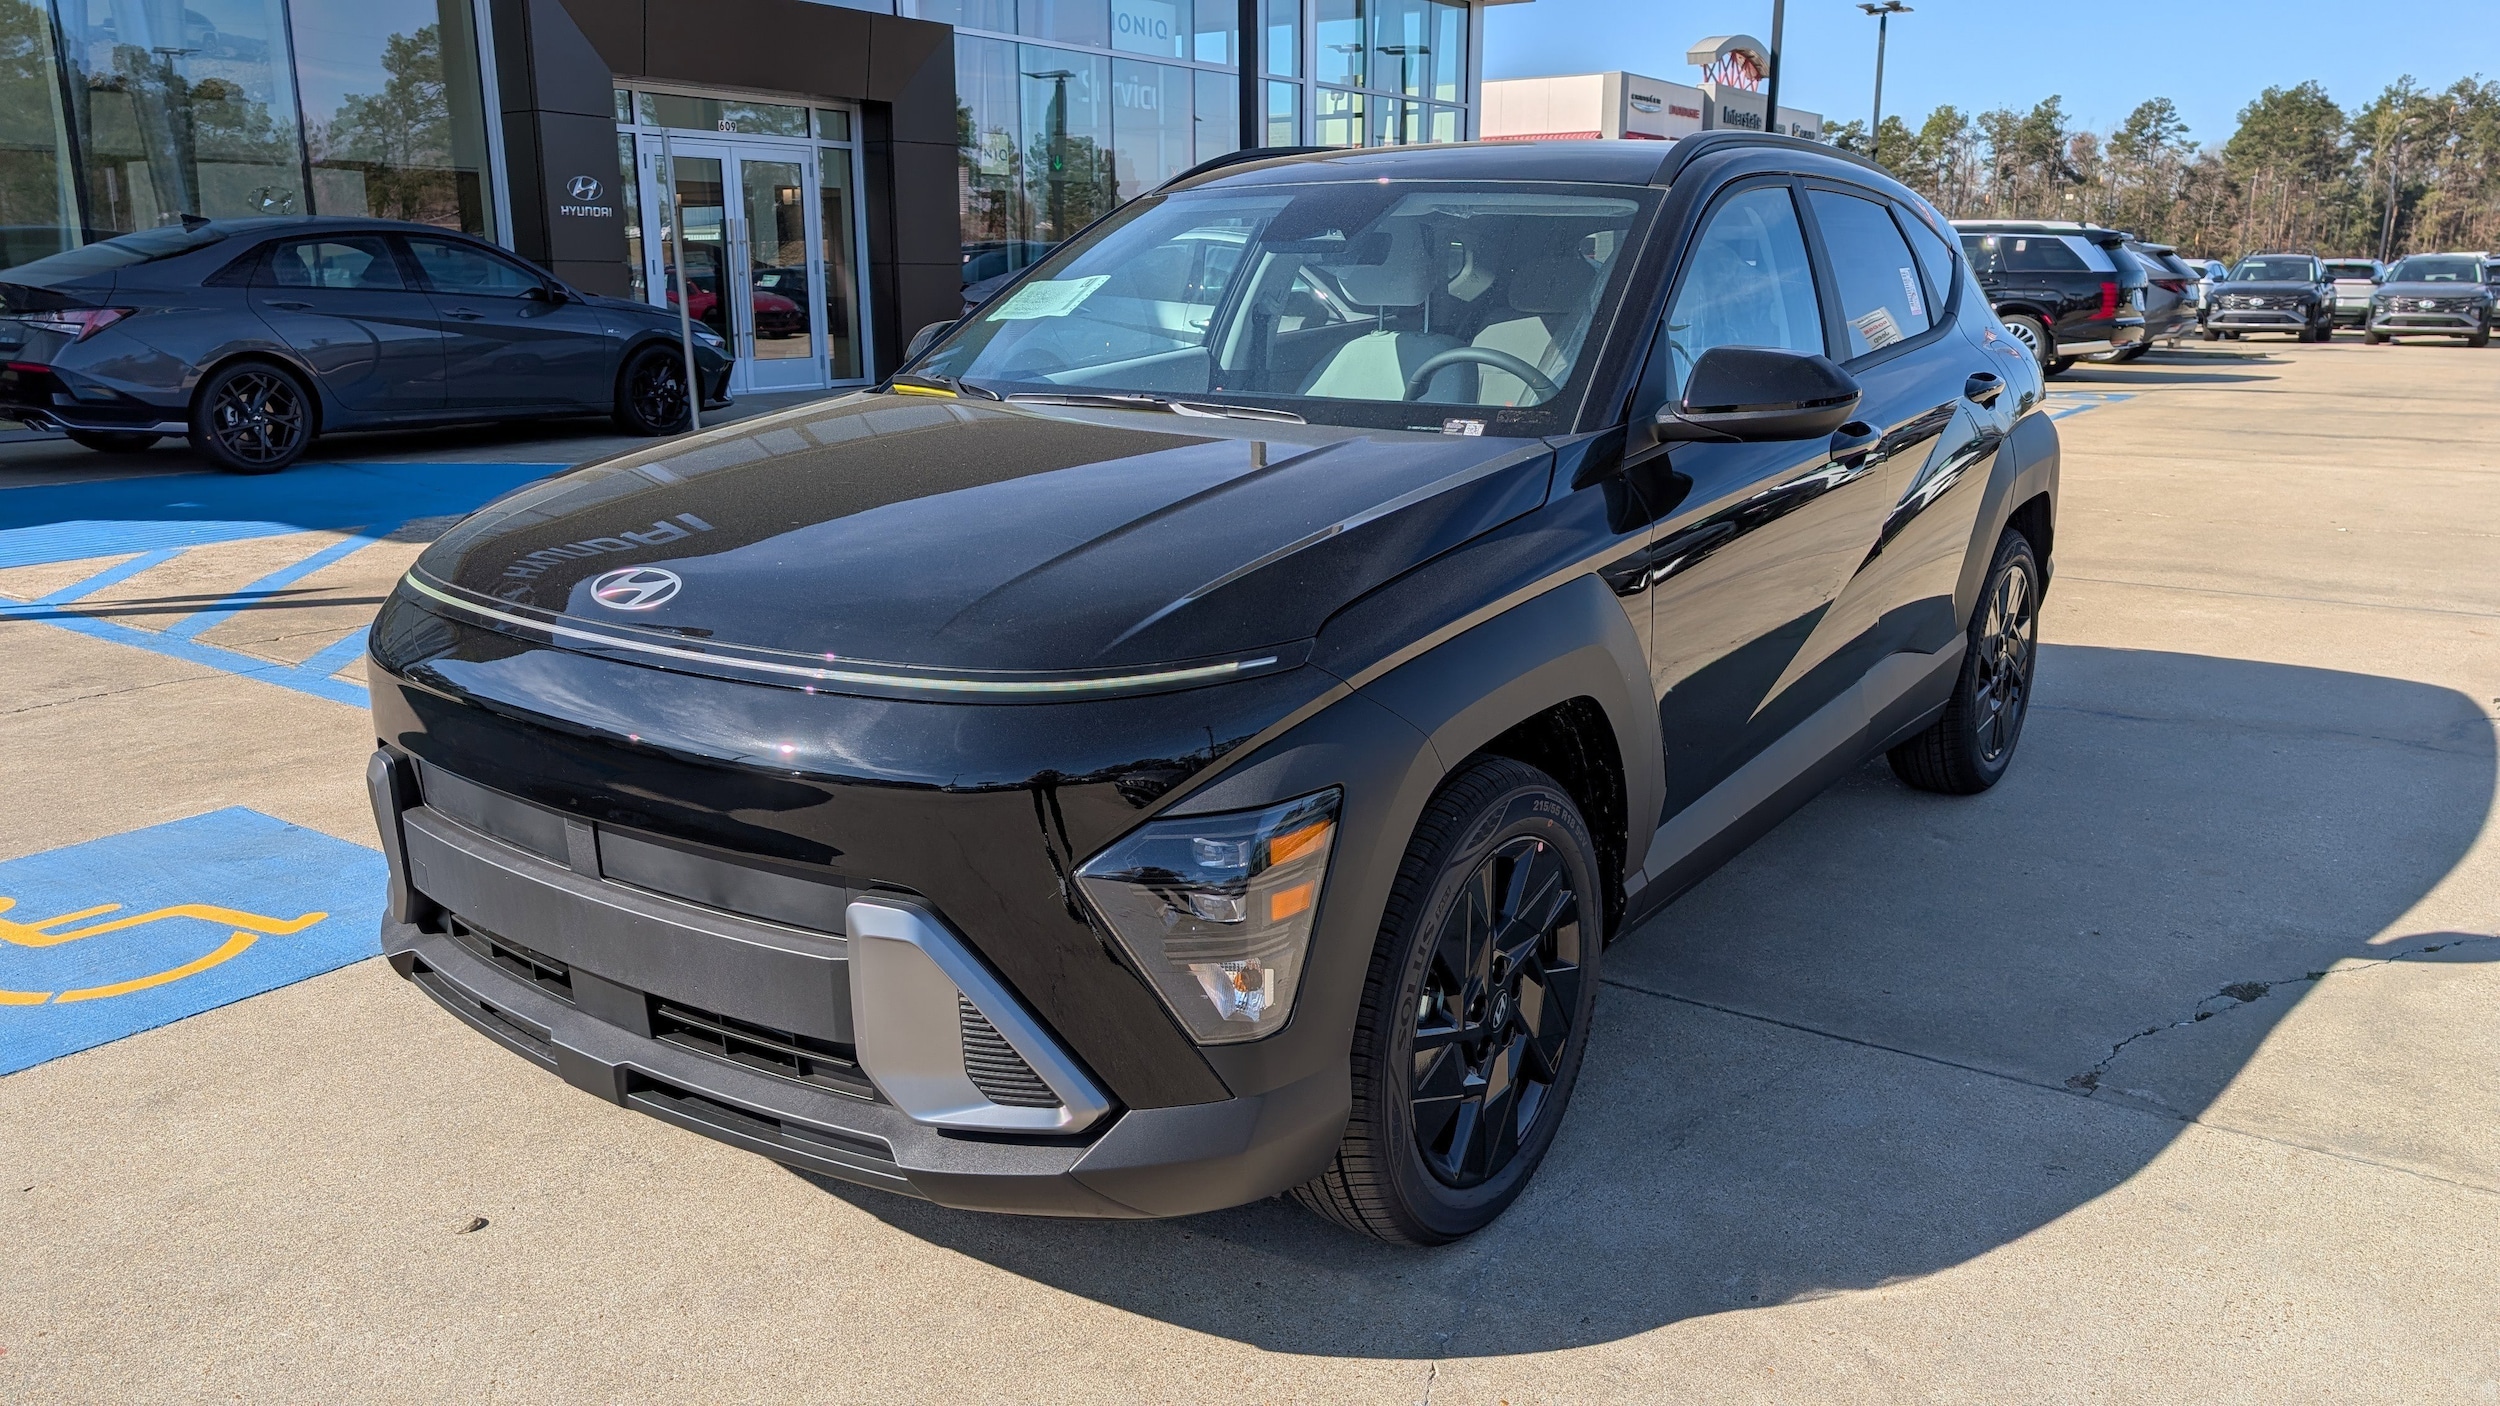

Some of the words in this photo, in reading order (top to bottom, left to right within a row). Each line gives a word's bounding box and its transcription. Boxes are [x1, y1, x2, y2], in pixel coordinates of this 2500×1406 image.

[1111, 11, 1168, 40] IONIQ
[719, 121, 736, 131] 609
[560, 205, 613, 218] HYUNDAI
[1533, 800, 1561, 816] 215/55
[1561, 809, 1576, 829] R18
[1398, 921, 1435, 1050] SOLUS
